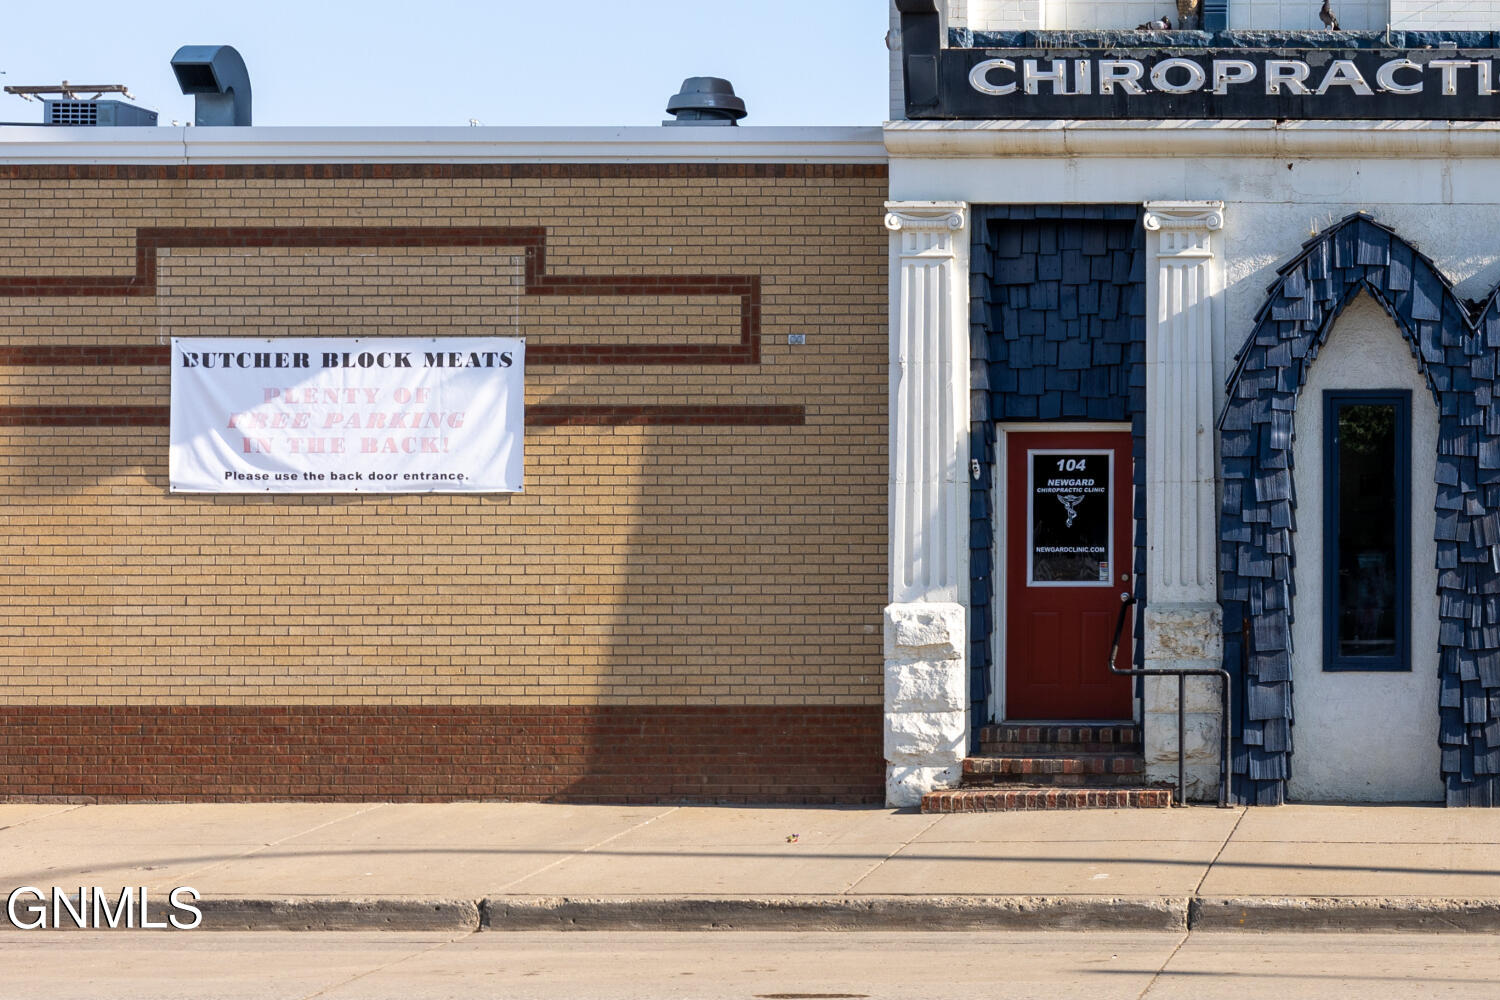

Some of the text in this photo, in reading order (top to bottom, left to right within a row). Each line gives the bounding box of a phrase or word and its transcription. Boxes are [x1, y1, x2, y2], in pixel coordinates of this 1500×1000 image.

[182, 351, 513, 369] BUTCHER BLOCK MEATS
[263, 387, 431, 405] PLENTY OF
[226, 411, 466, 429] FREE PARKING
[242, 436, 449, 454] IN THE BACK!
[1056, 458, 1087, 472] 104
[224, 471, 469, 481] Please use the back door entrance.
[1047, 478, 1095, 487] NEWGARD
